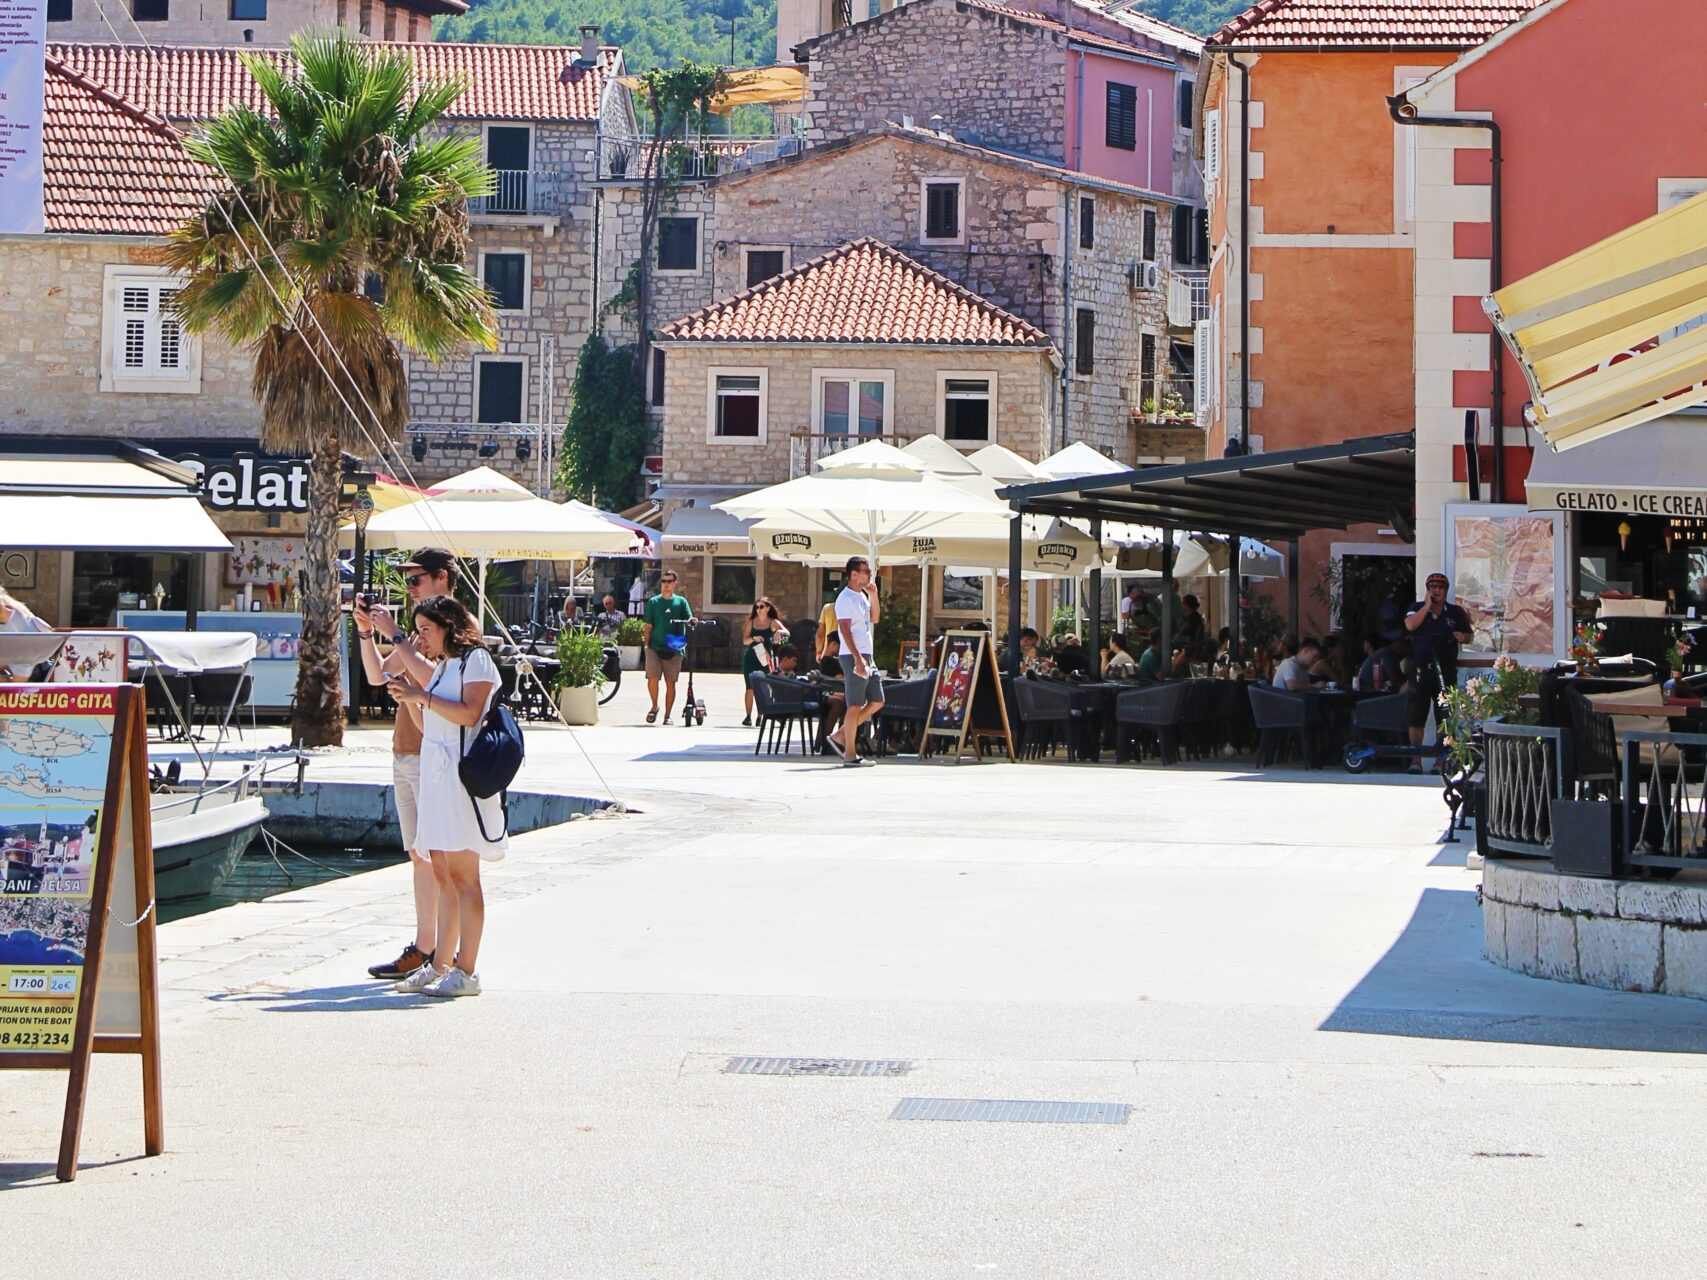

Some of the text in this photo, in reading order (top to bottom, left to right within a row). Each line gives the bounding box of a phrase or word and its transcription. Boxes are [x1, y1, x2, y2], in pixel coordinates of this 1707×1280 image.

[1556, 492, 1707, 516] GELATO ICE CREA
[913, 537, 935, 548] ŽUJA
[0, 693, 113, 709] AUSFLUG GITA
[40, 880, 80, 891] JELSA
[15, 978, 44, 989] 17:00
[31, 1006, 43, 1014] NA
[45, 1006, 74, 1014] BRODU
[19, 1017, 32, 1025] ON
[34, 1017, 49, 1025] THE
[51, 1017, 72, 1025] BOAT
[0, 1032, 70, 1046] 8 423 234
